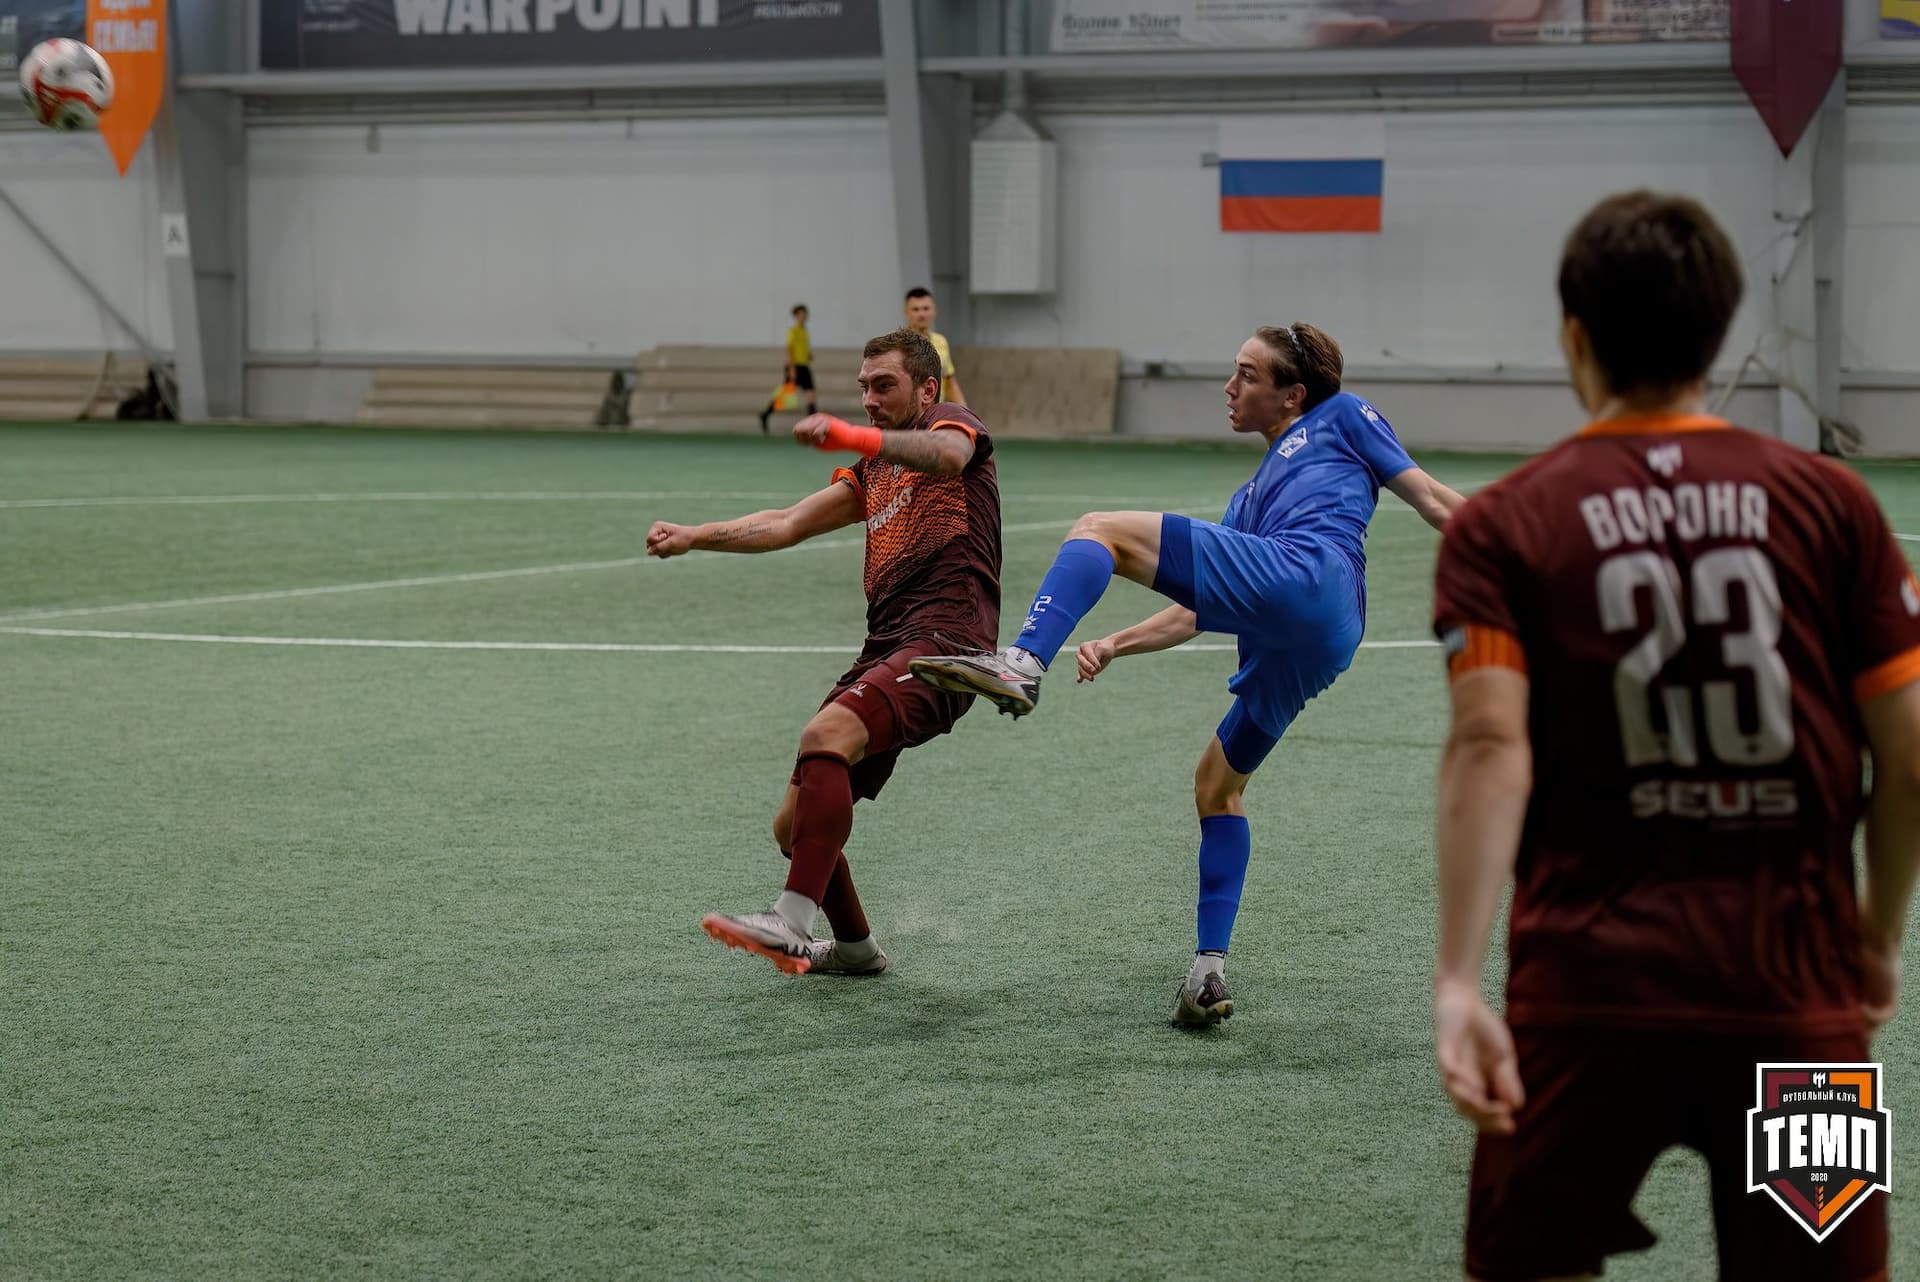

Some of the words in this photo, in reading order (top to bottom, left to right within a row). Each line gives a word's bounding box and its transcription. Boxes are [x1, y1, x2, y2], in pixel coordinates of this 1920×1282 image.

[393, 0, 720, 35] WARPOINT
[1580, 482, 1769, 550] ВОРОНА
[1595, 546, 1796, 768] 23
[1630, 779, 1799, 818] SEUS
